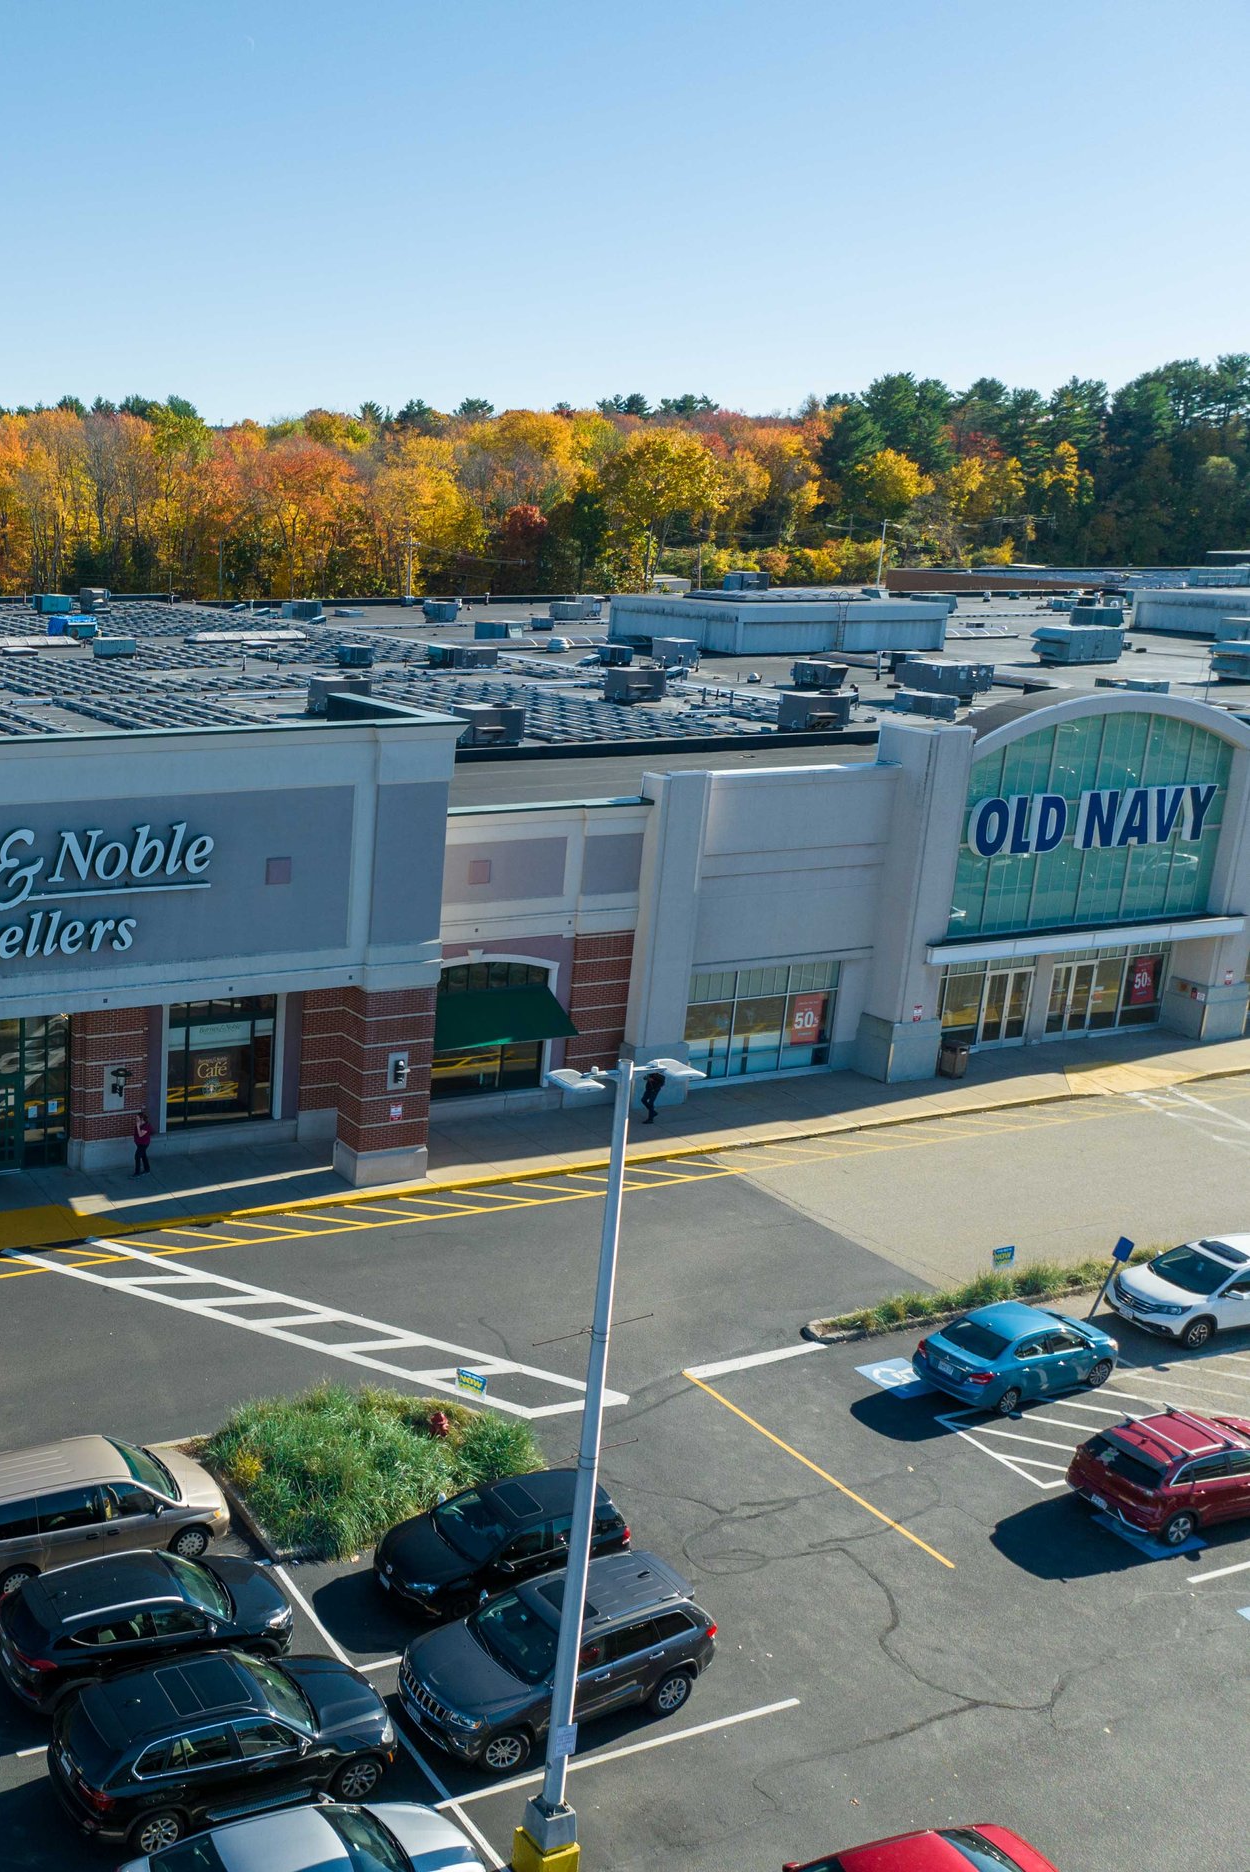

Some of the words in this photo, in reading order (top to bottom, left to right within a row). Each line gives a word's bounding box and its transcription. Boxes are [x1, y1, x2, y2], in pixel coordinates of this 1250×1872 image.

[968, 794, 1068, 857] OLD
[1073, 783, 1220, 850] NAVY
[47, 821, 215, 883] Noble
[197, 1061, 227, 1078] Café
